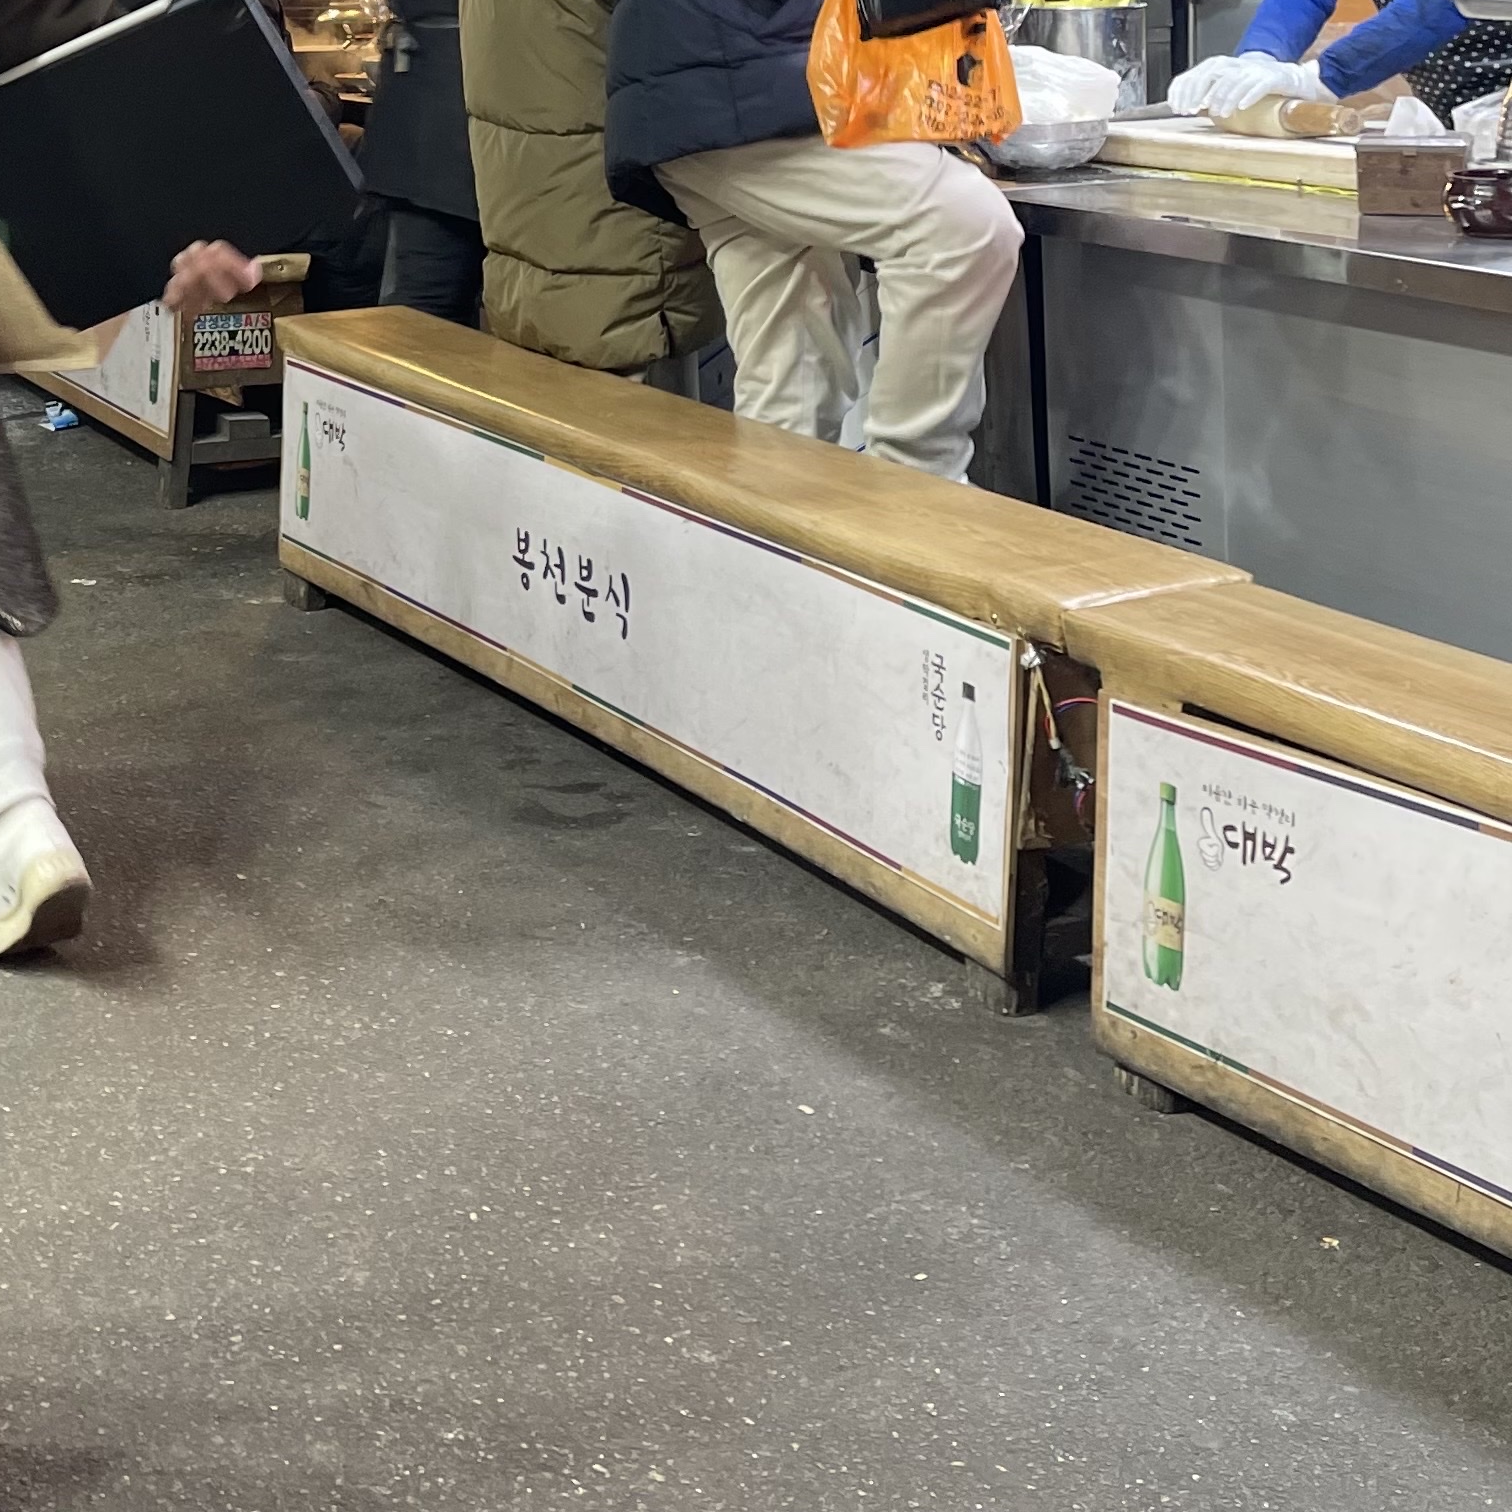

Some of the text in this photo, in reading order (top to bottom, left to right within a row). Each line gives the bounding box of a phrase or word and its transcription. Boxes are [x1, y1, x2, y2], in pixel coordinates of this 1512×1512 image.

[194, 330, 271, 356] 2238-4200
[512, 527, 632, 639] 봉천분식
[1223, 821, 1295, 885] 대박
